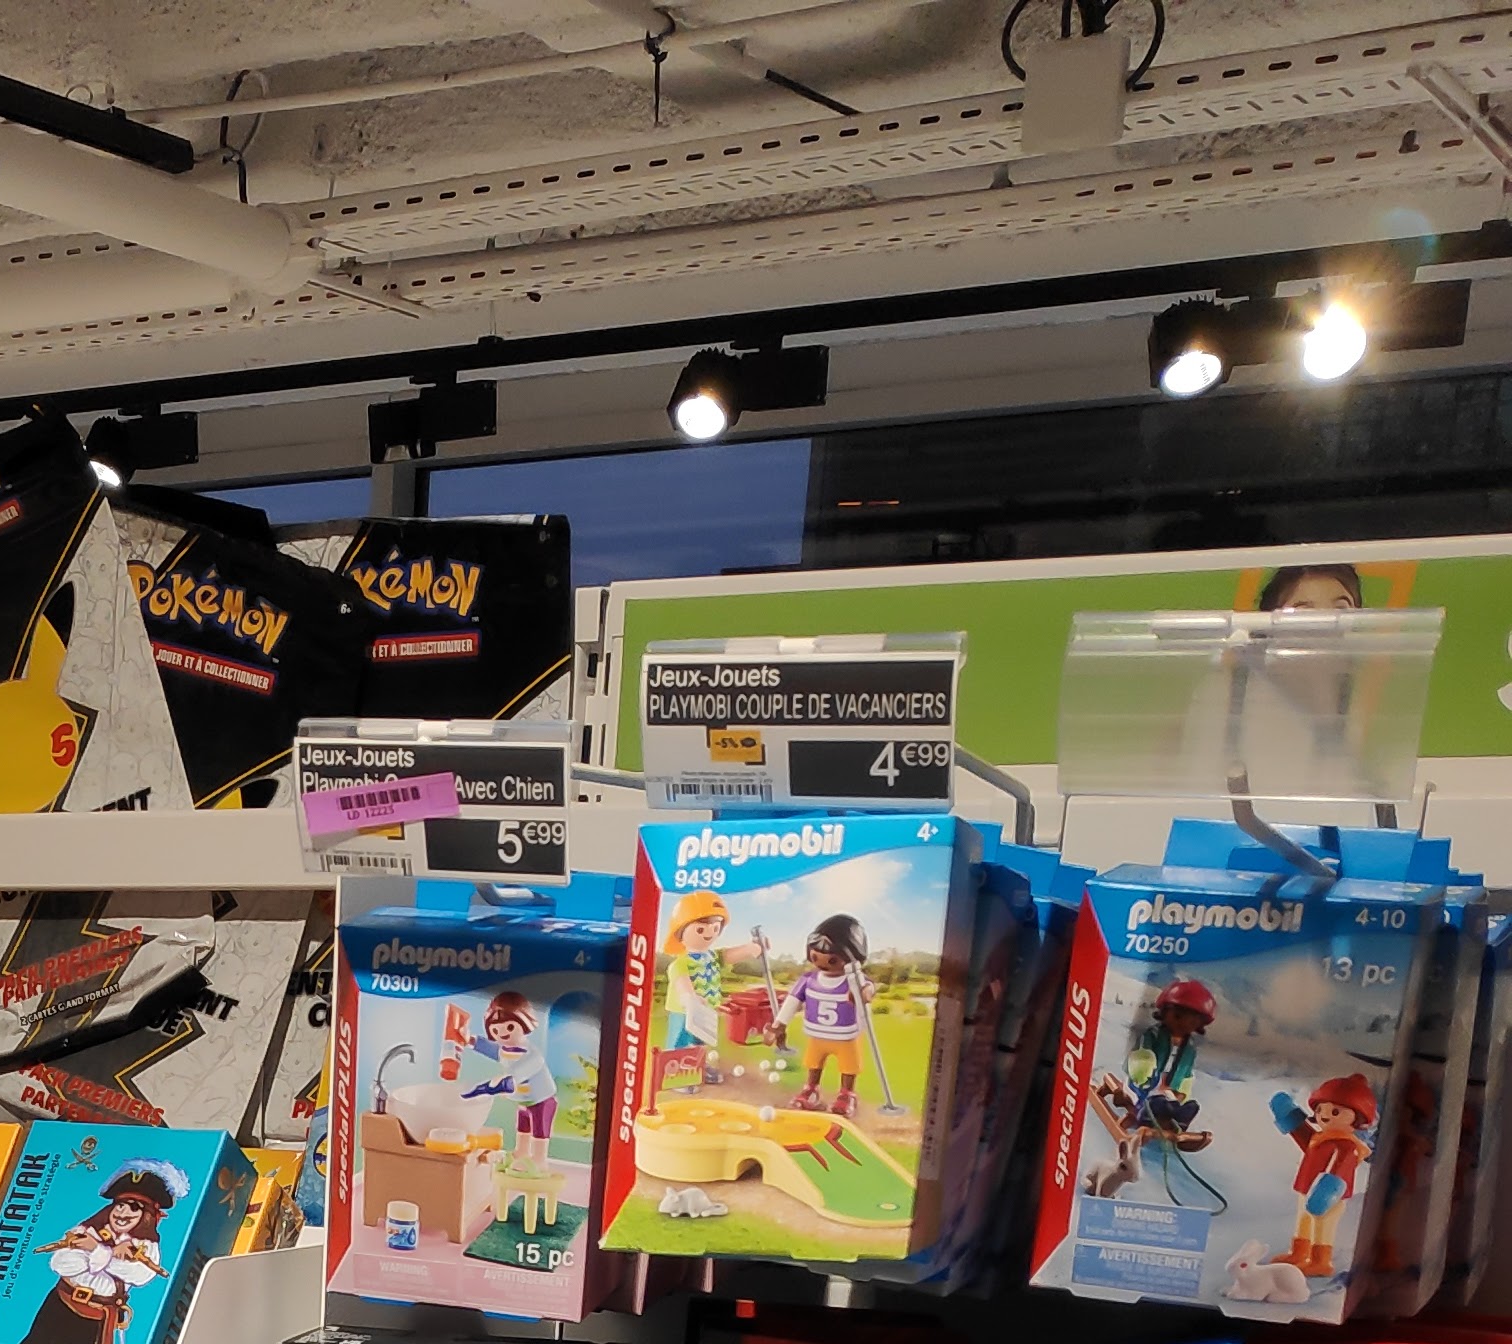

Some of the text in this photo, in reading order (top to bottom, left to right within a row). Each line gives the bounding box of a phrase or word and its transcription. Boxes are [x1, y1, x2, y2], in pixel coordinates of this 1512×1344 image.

[204, 661, 269, 690] COLLECTIONNER
[649, 664, 781, 690] Jeux-Jouets
[649, 693, 947, 721] PLAYMOBI COUPLE DE VACANCIERS
[50, 722, 77, 768] 5
[301, 746, 415, 768] Jeux-Jouets
[454, 775, 555, 801] Avec Chien
[676, 823, 844, 867] playmobil
[674, 867, 726, 889] 9439
[1127, 894, 1303, 935] playmobil
[1354, 907, 1406, 929] 4-10
[372, 942, 511, 973] playmobil
[1124, 935, 1189, 957] 70250
[371, 973, 420, 993] 70301
[1361, 963, 1396, 987] pc
[817, 1002, 839, 1025] 5
[68, 1076, 165, 1127] PREMIERS
[514, 1242, 575, 1270] 15 pc
